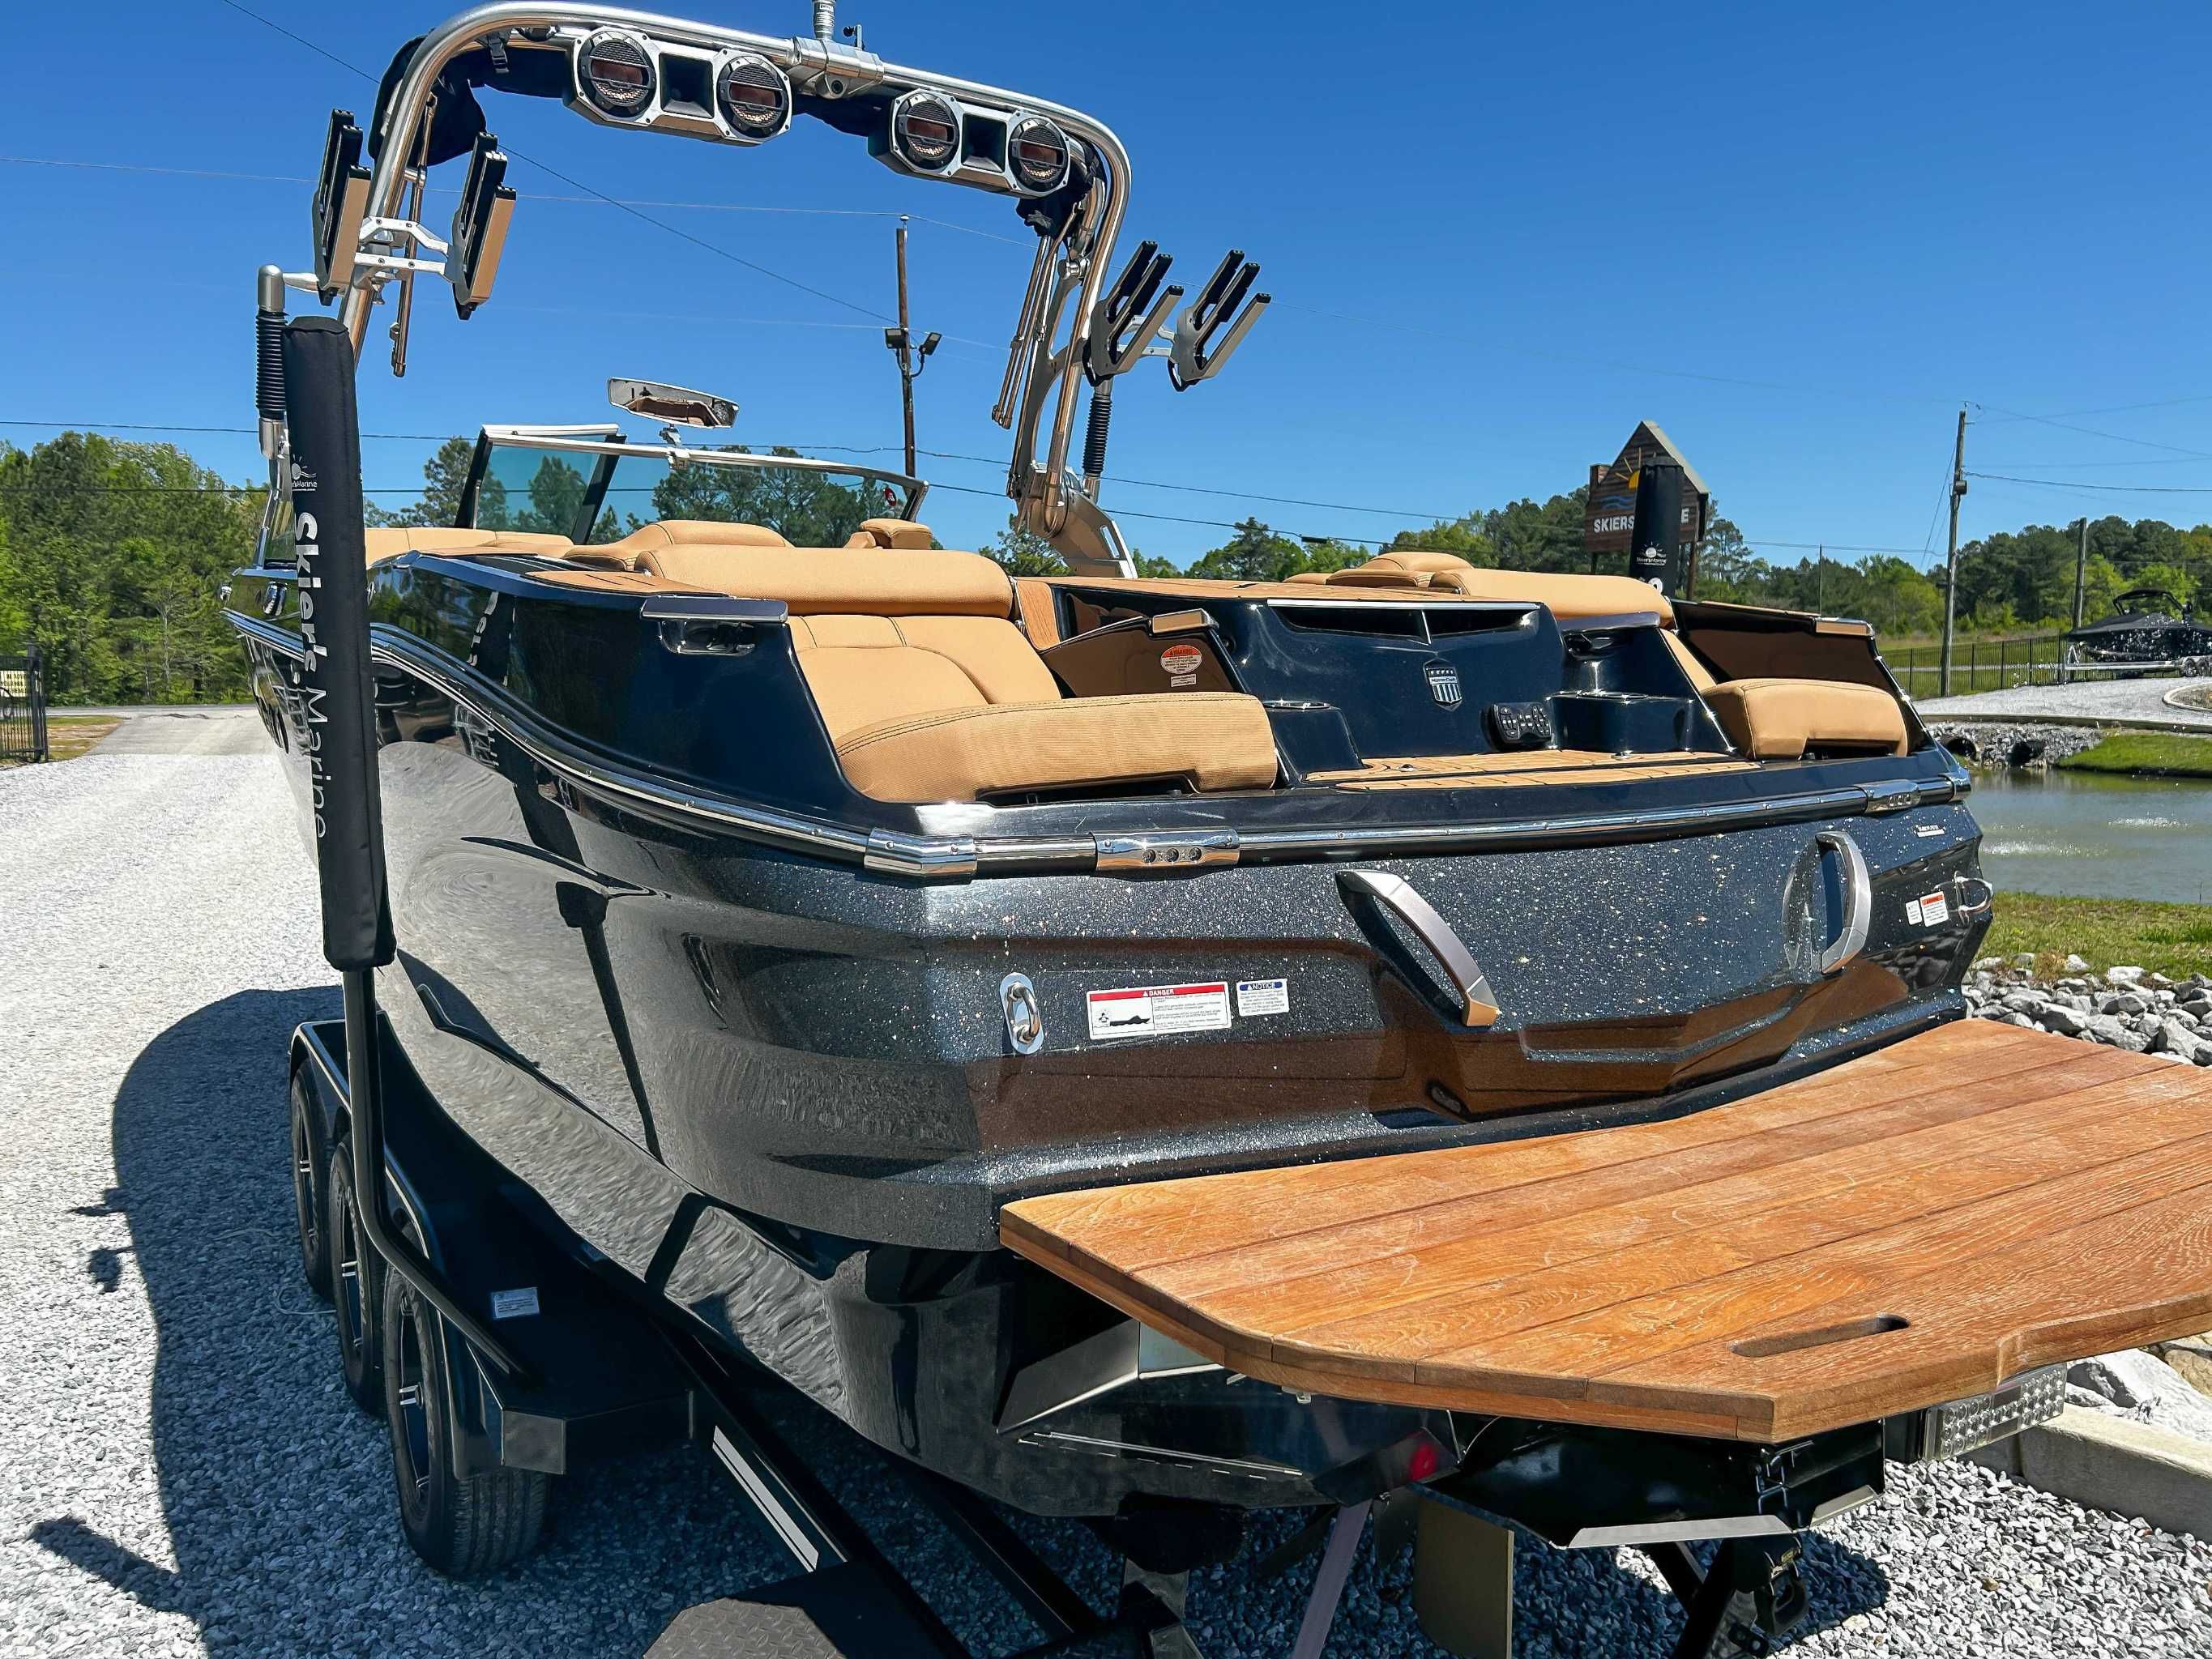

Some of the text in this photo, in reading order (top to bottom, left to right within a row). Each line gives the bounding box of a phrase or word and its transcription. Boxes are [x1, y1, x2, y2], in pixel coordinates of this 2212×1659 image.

[294, 512, 327, 673] Skier's
[305, 686, 331, 838] Marine
[1148, 988, 1175, 997] DANGER
[1252, 982, 1277, 990] NOTICE
